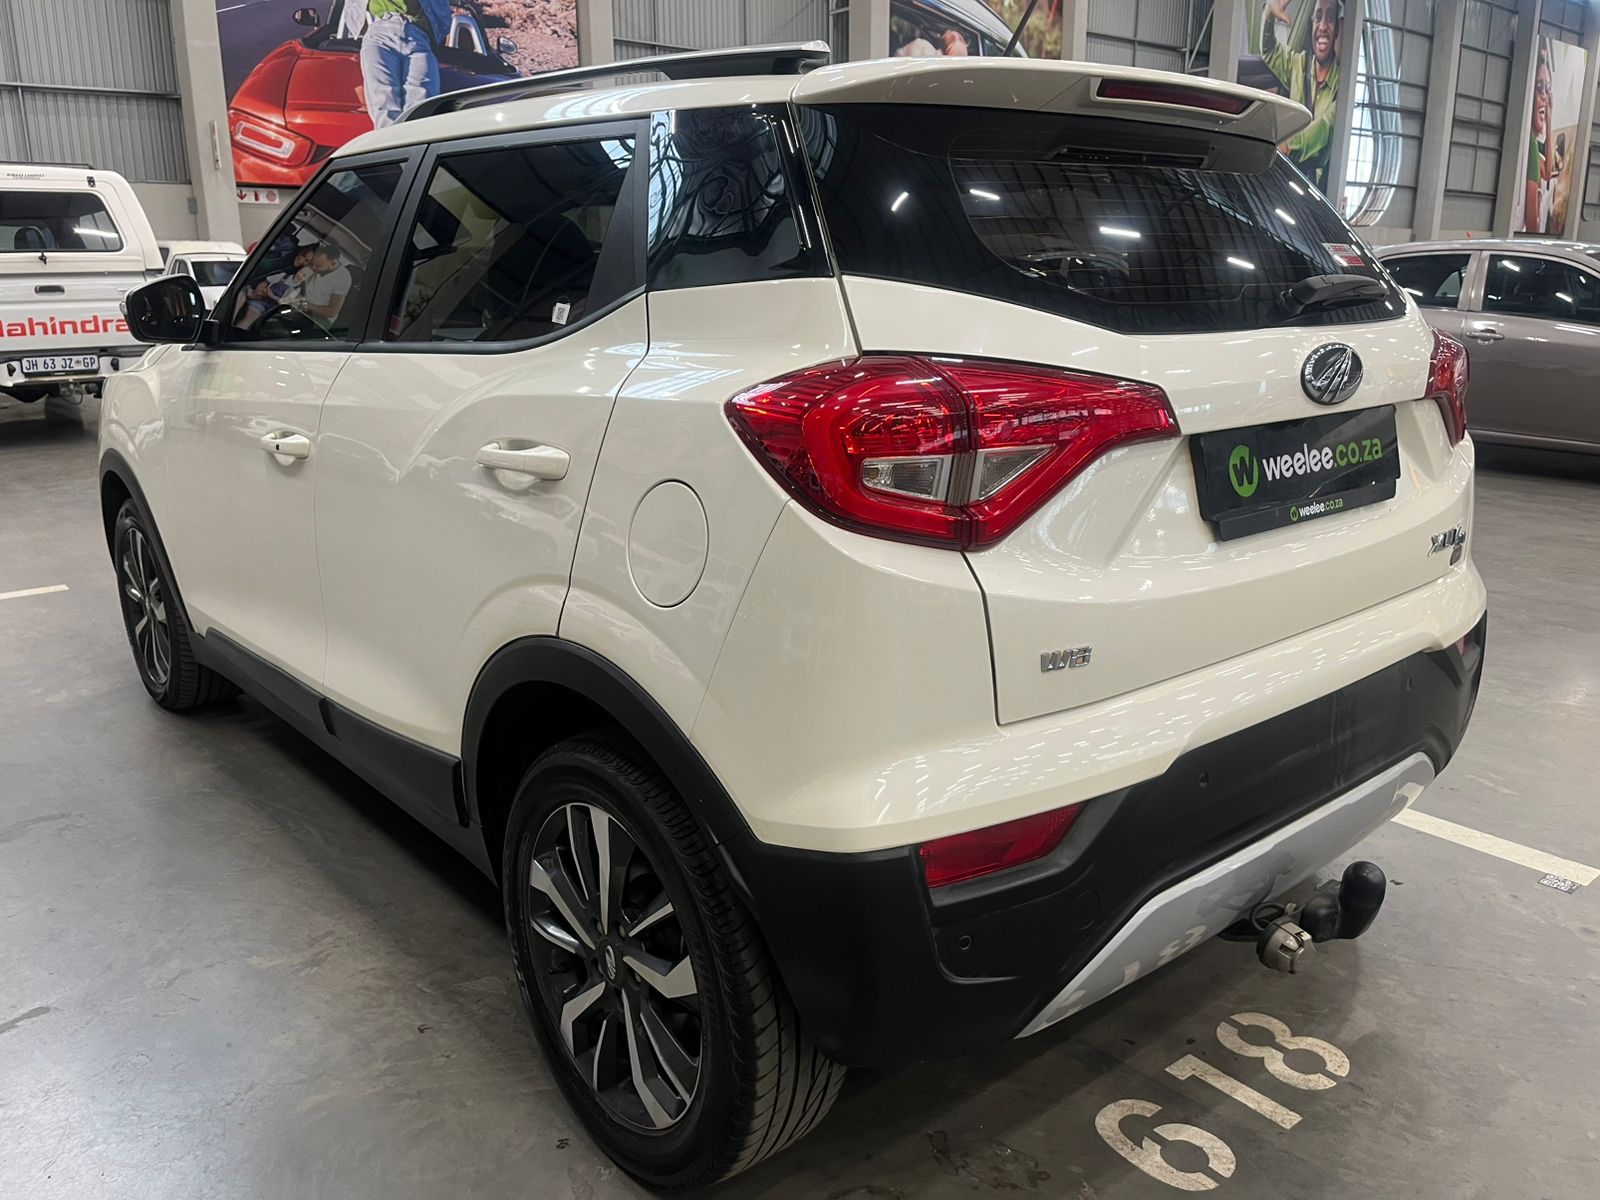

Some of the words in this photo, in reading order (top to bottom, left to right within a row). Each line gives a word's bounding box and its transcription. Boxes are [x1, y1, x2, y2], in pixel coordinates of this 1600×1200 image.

[0, 315, 129, 337] ahindra
[25, 359, 38, 371] JH
[43, 358, 56, 370] 63
[61, 357, 74, 369] JZ
[82, 356, 96, 368] GP
[1262, 437, 1383, 482] weelee.co.za
[1299, 497, 1344, 518] weelee.co.za
[1094, 1011, 1350, 1192] 618
